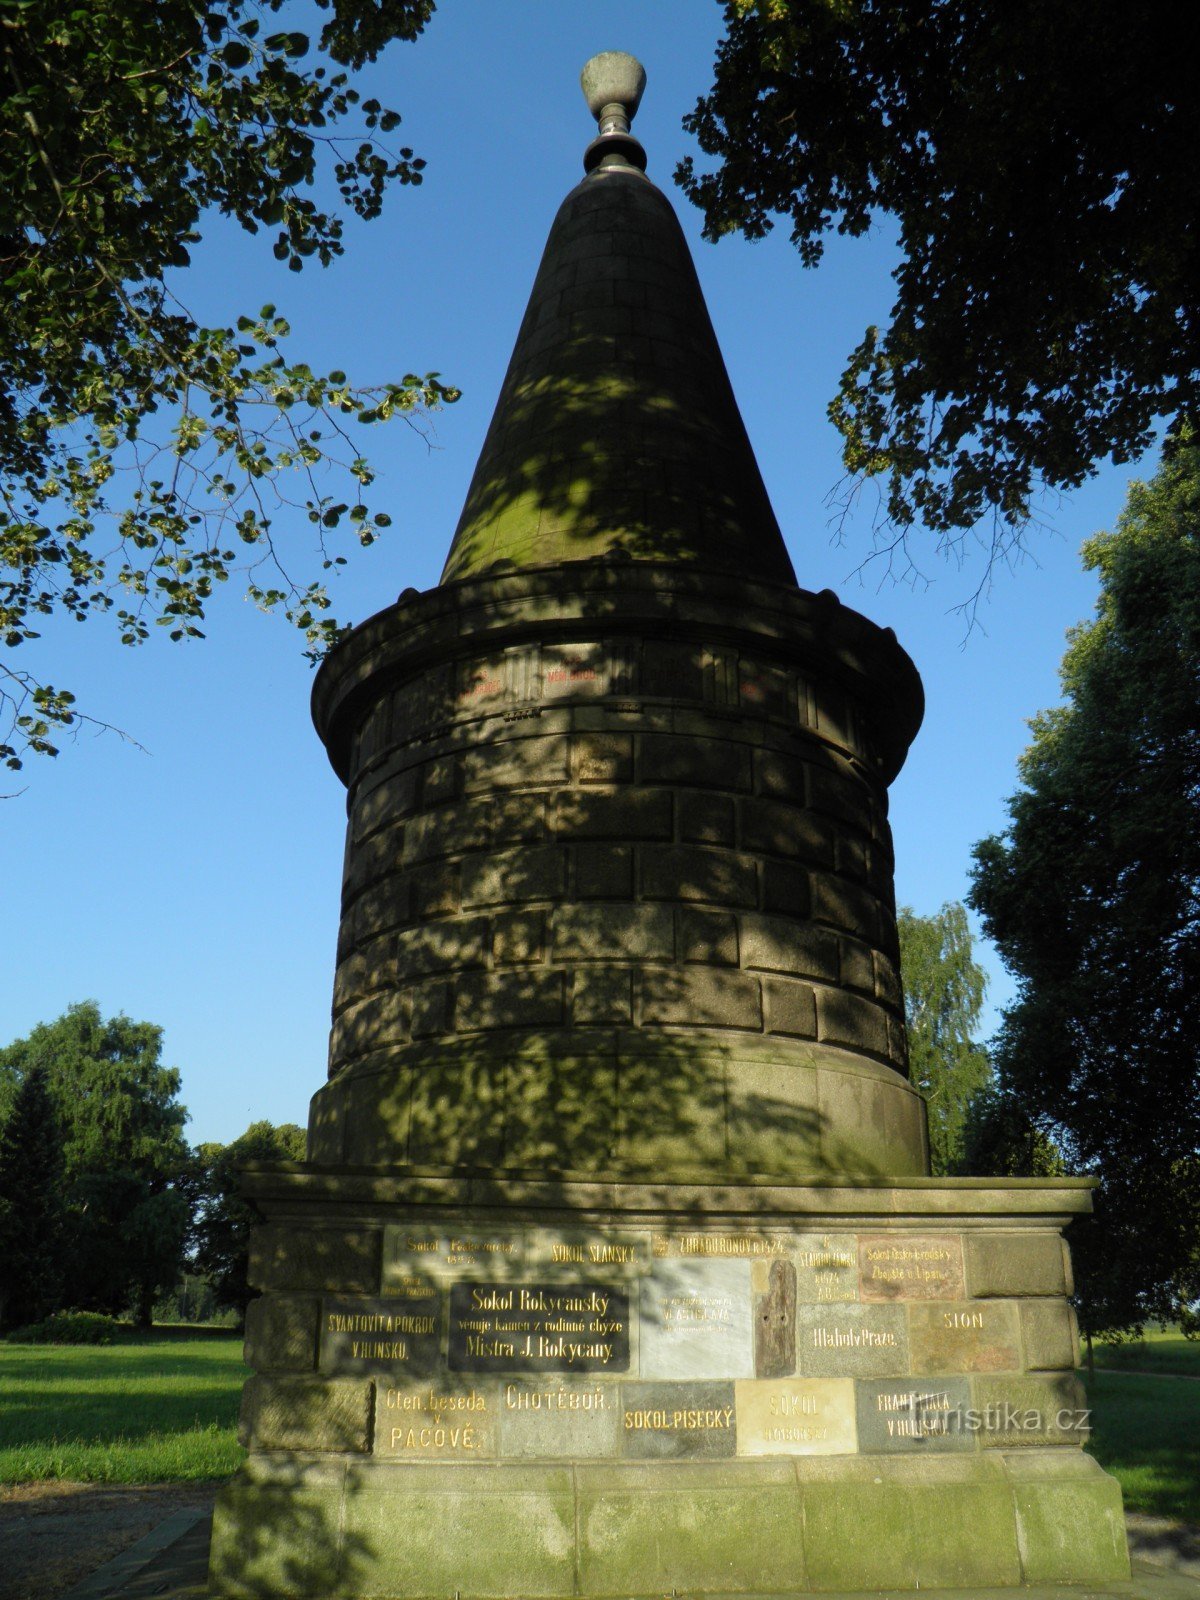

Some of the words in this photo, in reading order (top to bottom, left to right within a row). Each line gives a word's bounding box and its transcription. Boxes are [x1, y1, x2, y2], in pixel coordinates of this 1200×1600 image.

[552, 1244, 585, 1263] SOKOL
[472, 1287, 514, 1312] Sokol
[520, 1288, 610, 1317] Rokycanský
[387, 1316, 394, 1332] A
[394, 1315, 436, 1334] POKROK
[533, 1320, 541, 1331] z
[544, 1317, 586, 1333] rodinné
[589, 1318, 624, 1337] chýže
[943, 1312, 984, 1329] SION
[813, 1327, 854, 1348] Hlahol
[861, 1328, 898, 1347] Praze.
[352, 1341, 360, 1359] V
[360, 1341, 410, 1361] HLINSKU.
[465, 1335, 514, 1358] Mistra
[519, 1335, 534, 1358] J.
[538, 1335, 615, 1364] Rokycany.
[429, 1388, 487, 1411] beseda
[768, 1394, 819, 1417] SOKOL
[625, 1409, 670, 1430] SOKOL
